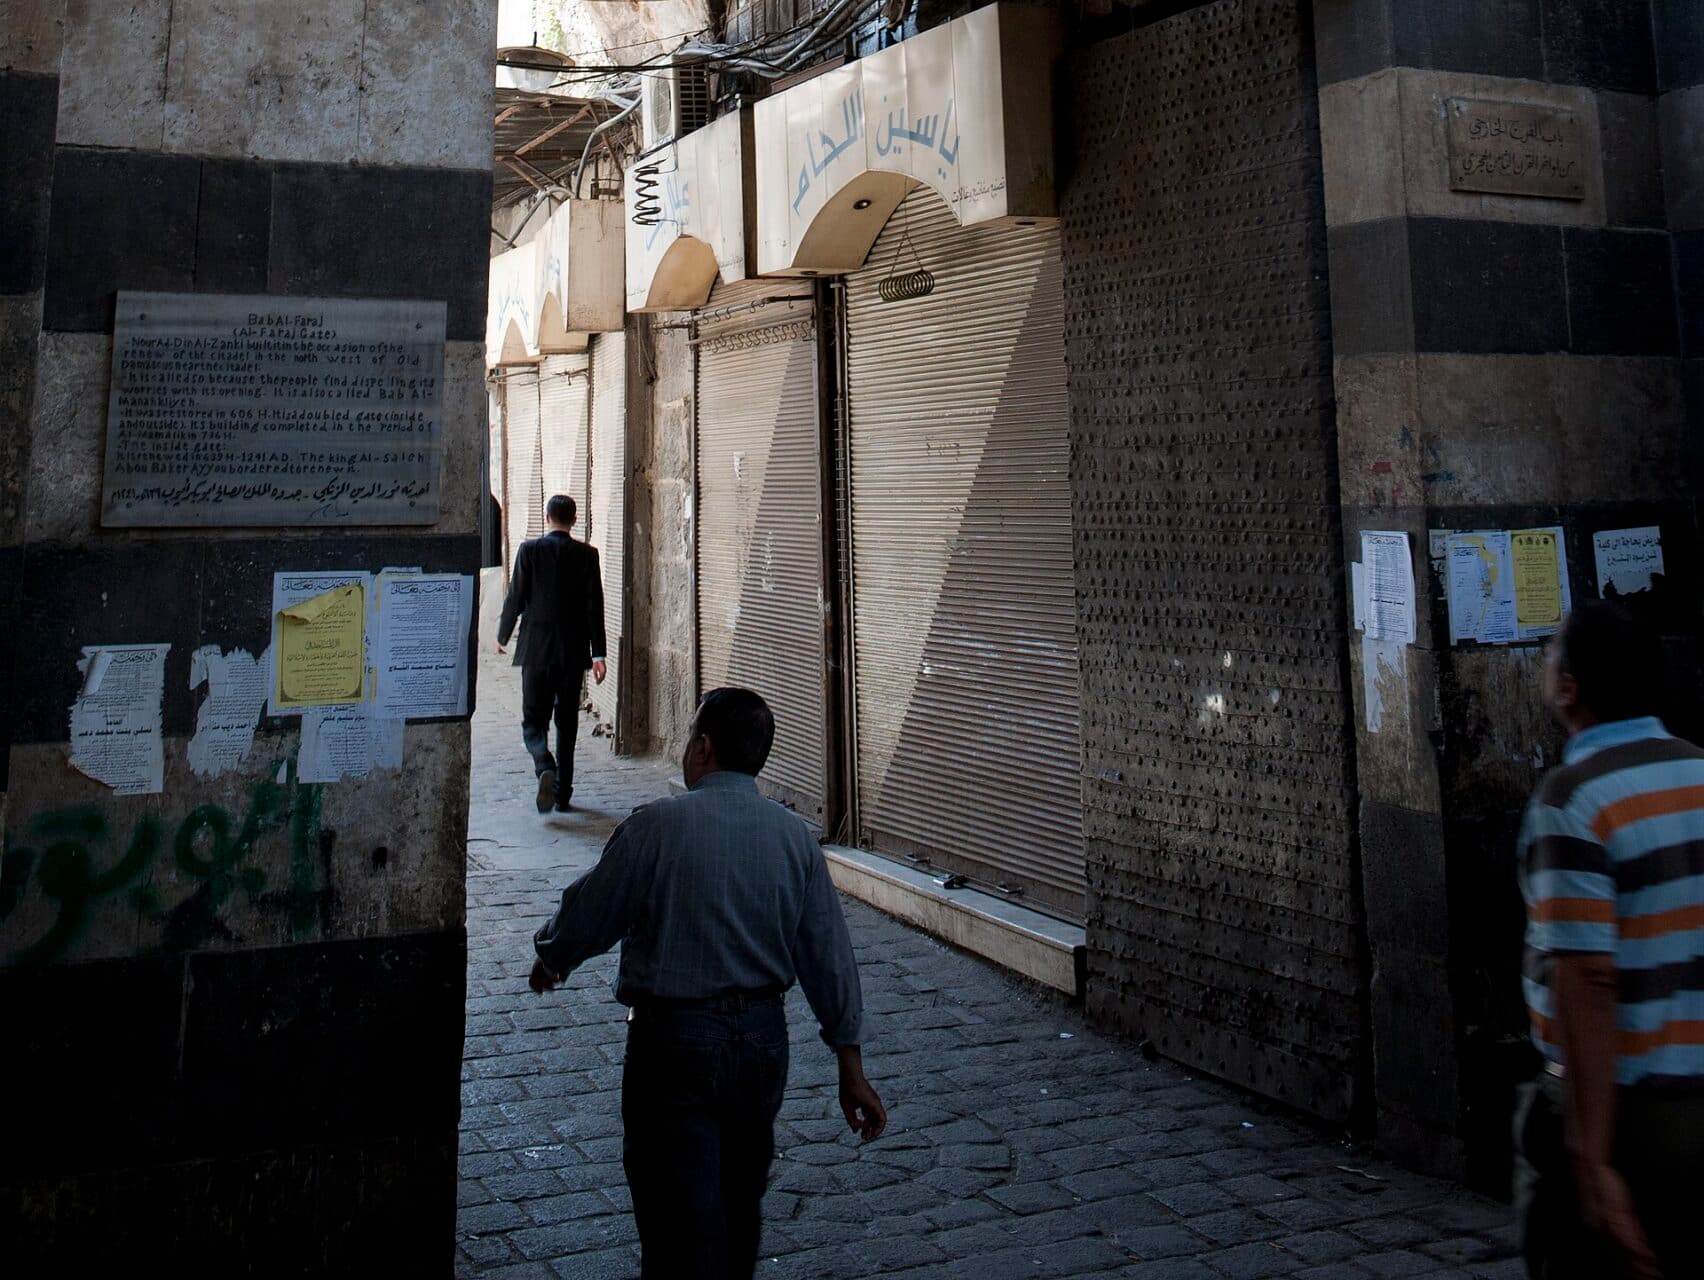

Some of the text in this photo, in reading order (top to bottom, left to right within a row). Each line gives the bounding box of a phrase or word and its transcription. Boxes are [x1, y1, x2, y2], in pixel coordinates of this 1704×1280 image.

[876, 93, 960, 180] ياسين
[1470, 118, 1563, 148] باب الفرج الخارجي
[793, 88, 864, 217] اللحام
[247, 313, 323, 328] Bab Al-Faraj
[300, 327, 336, 340] Gate)
[173, 349, 187, 360] of
[269, 351, 286, 362] the
[327, 354, 361, 365] west
[371, 354, 385, 366] of
[208, 373, 255, 386] because
[379, 388, 404, 400] Bab
[209, 420, 259, 433] building
[262, 422, 328, 433] completed
[331, 422, 343, 433] in
[348, 422, 371, 433] the
[300, 452, 325, 464] The
[312, 476, 351, 503] الزنكي
[350, 482, 382, 504] الدين
